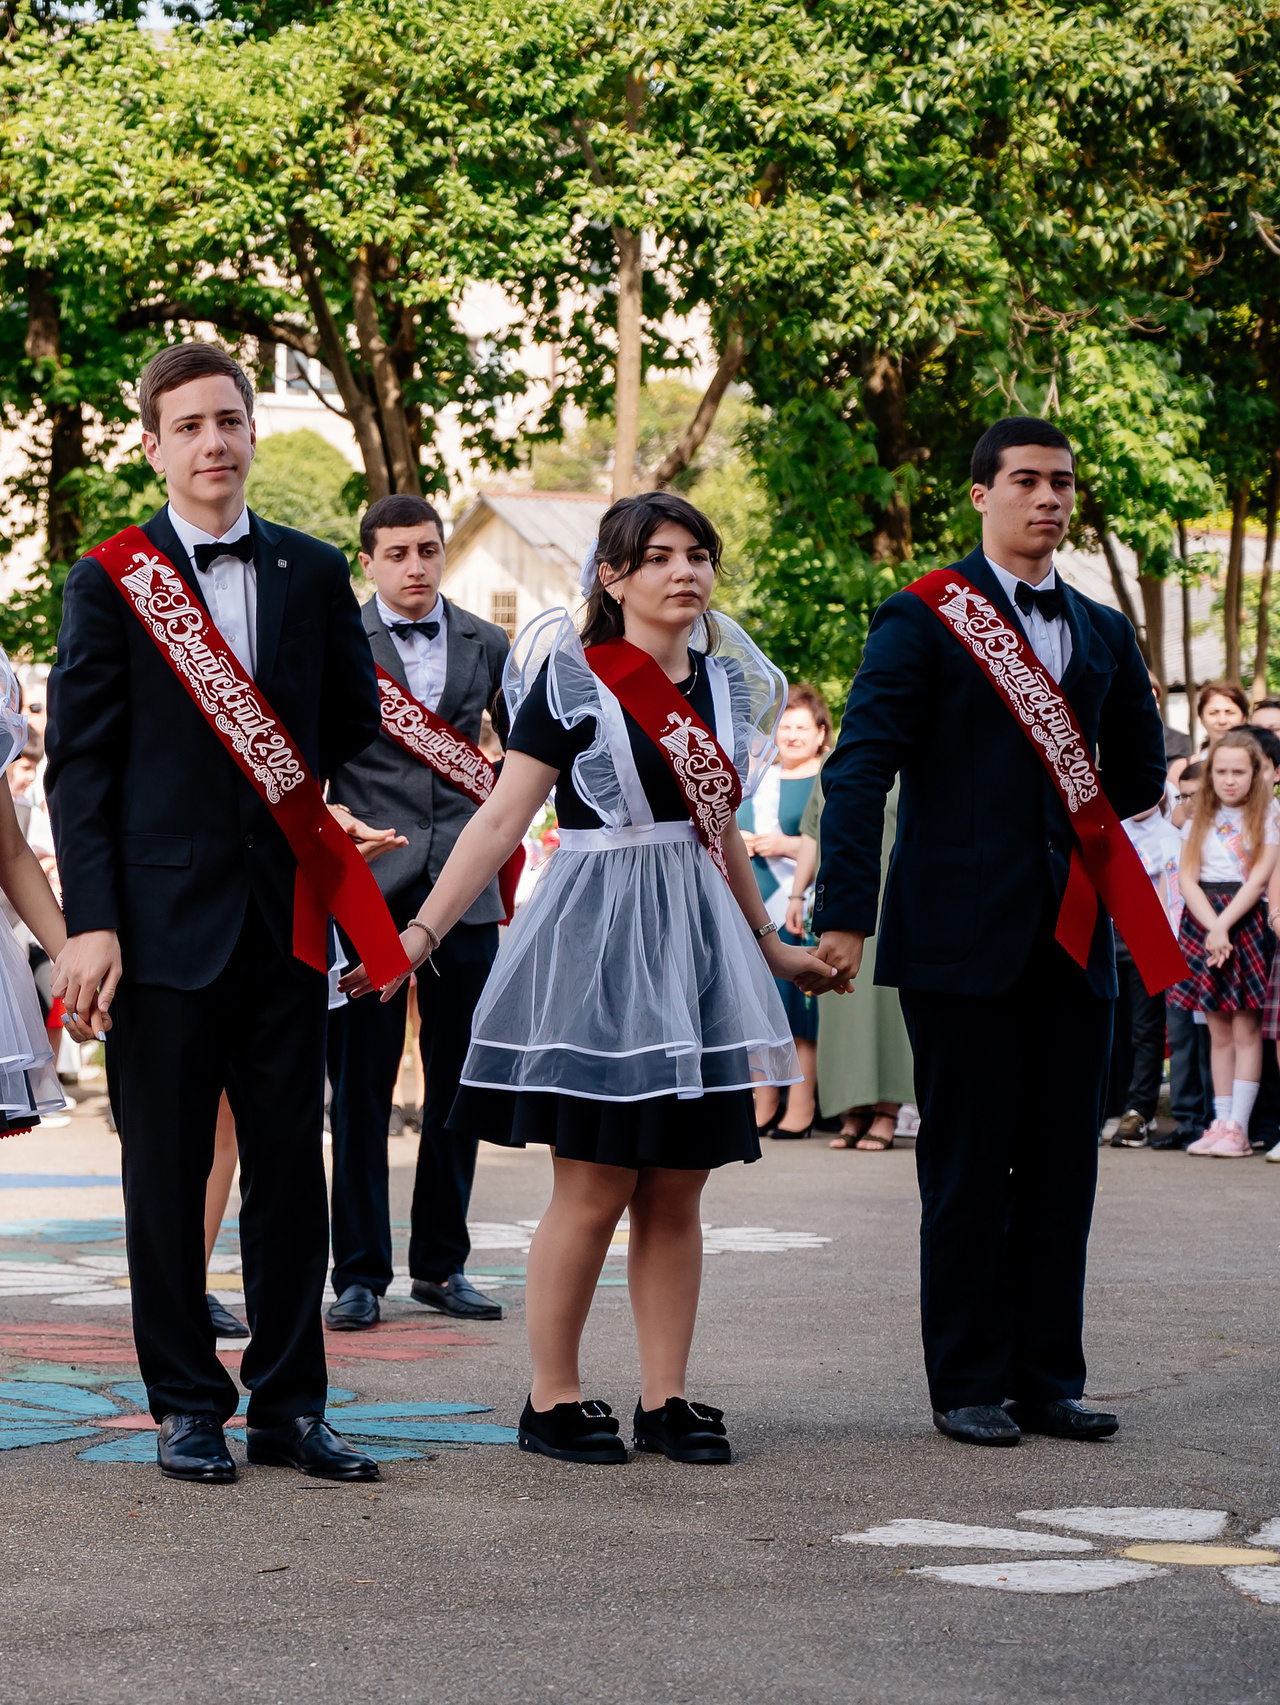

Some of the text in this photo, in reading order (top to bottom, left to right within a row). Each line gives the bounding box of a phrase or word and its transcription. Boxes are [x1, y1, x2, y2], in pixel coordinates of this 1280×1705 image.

[148, 592, 305, 792] Выпускник 2023
[476, 763, 495, 793] 202
[966, 616, 1099, 803] Выпускник 2023
